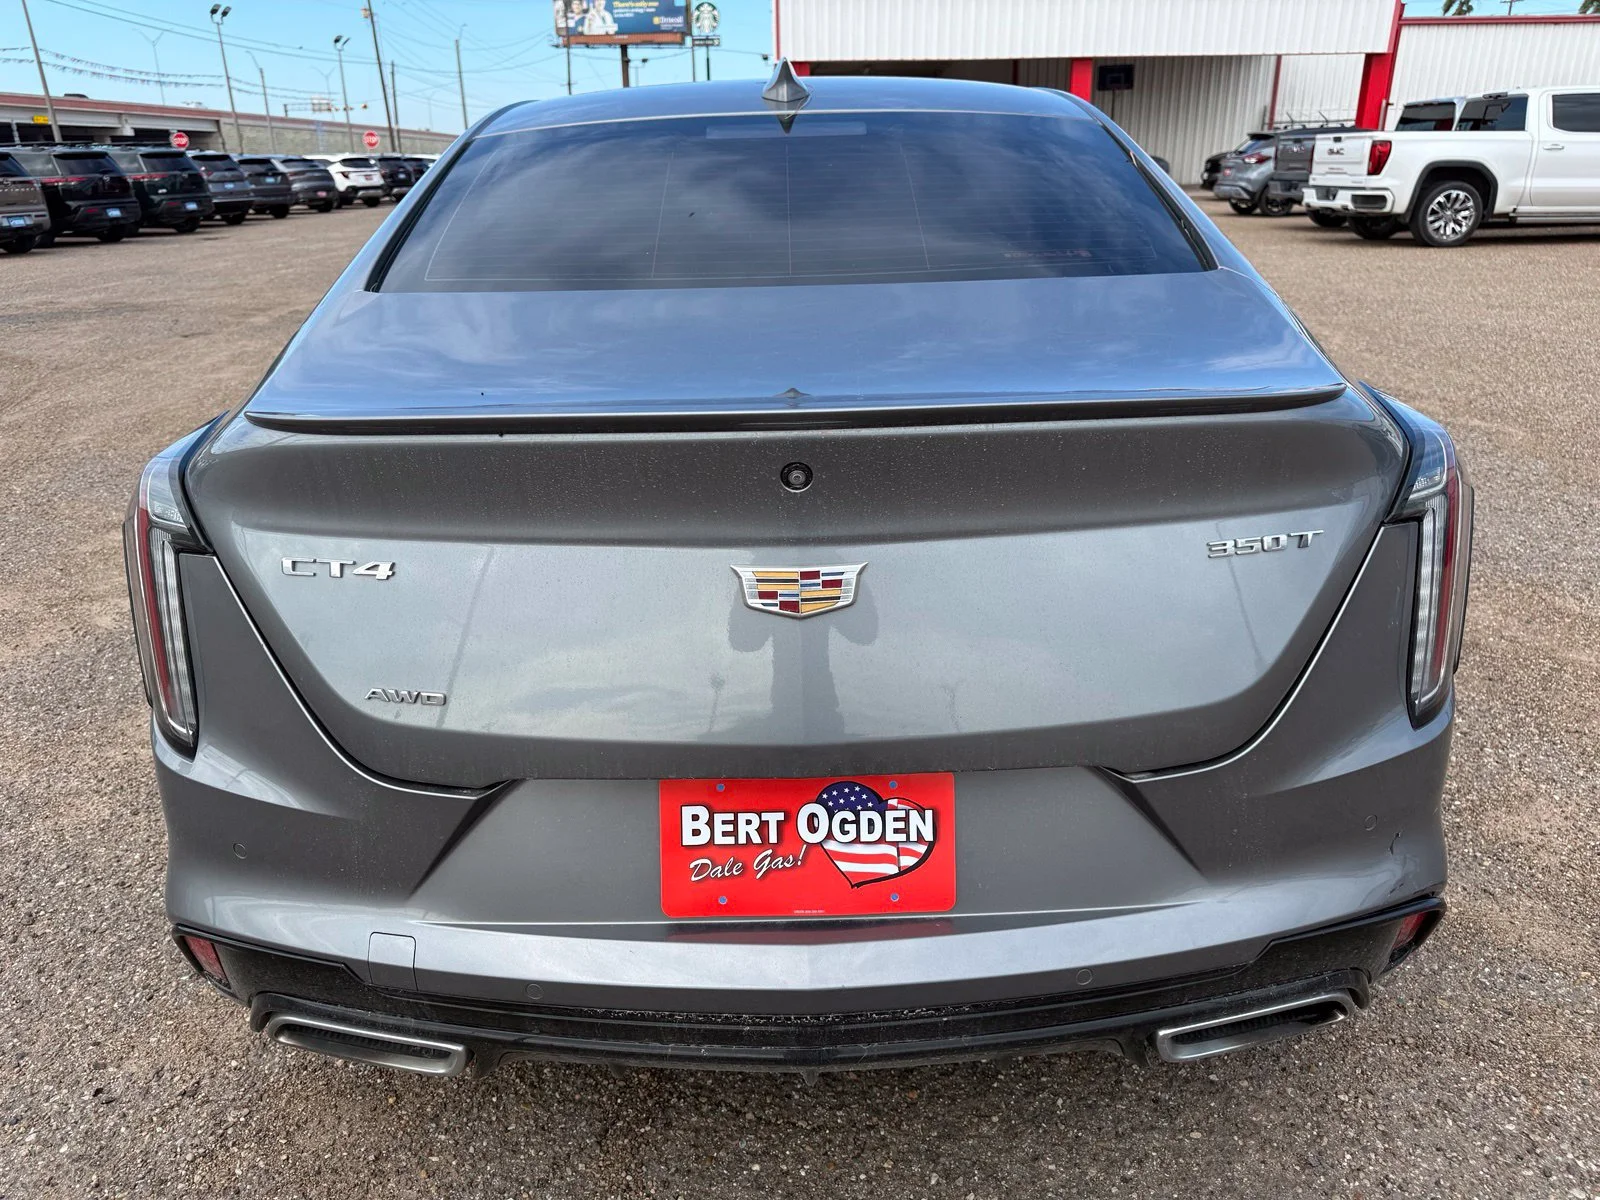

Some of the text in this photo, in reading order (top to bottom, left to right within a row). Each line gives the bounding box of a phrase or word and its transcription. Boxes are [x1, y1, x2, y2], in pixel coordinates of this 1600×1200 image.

[172, 137, 188, 145] STOP
[363, 135, 379, 143] STOP
[1327, 148, 1345, 156] GMC
[281, 557, 396, 581] CT4
[364, 688, 448, 706] AWD
[680, 802, 935, 846] BERT OGDEN
[689, 844, 808, 882] Dale Gas!
